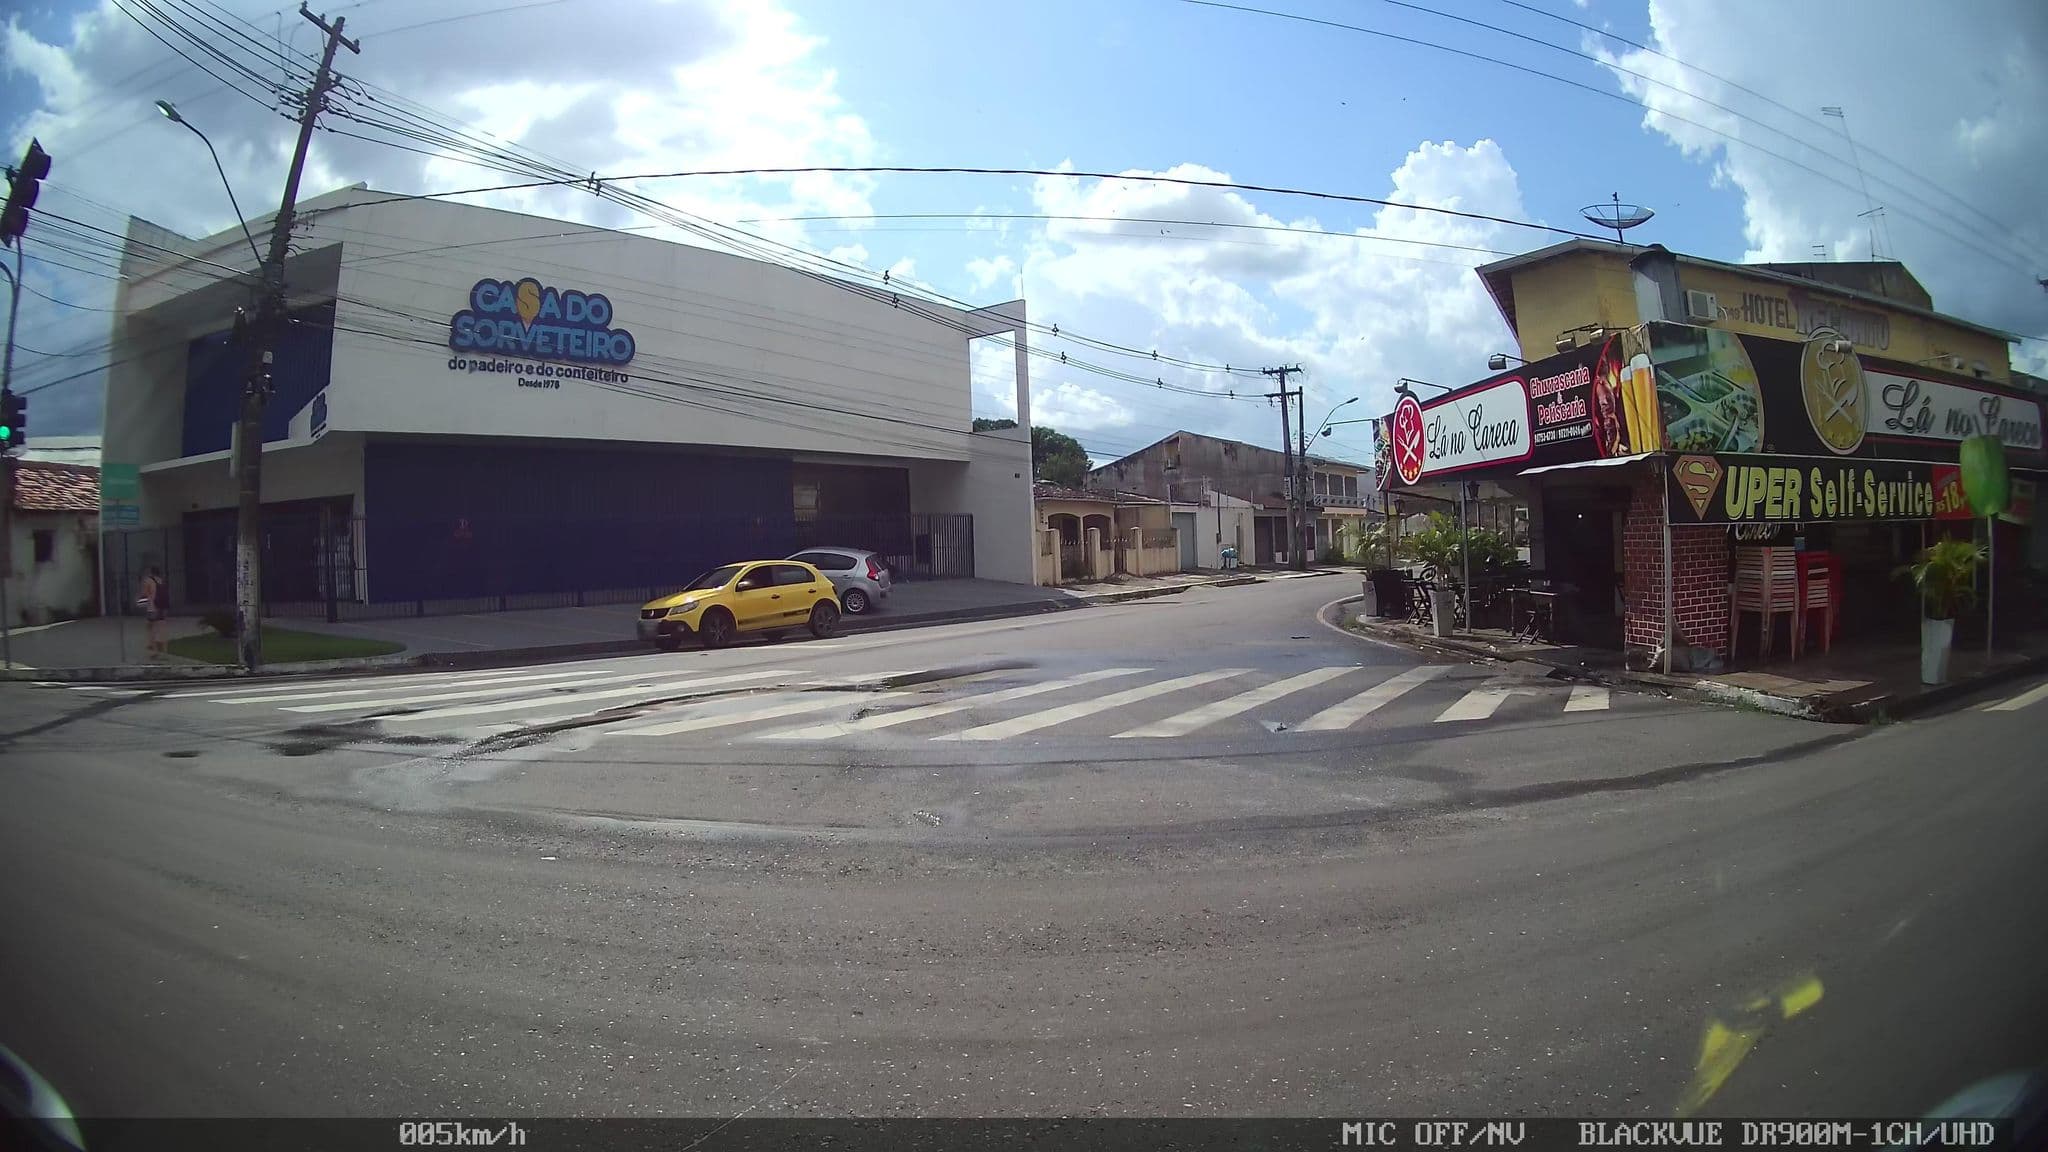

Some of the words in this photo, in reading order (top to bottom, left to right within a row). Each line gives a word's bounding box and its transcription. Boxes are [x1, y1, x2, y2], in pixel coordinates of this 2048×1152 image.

[475, 281, 561, 319] CASA
[566, 294, 609, 325] DO
[1741, 292, 1797, 331] HOTEL
[454, 315, 633, 360] SORVETEIRO
[448, 357, 466, 370] do
[468, 359, 523, 374] padeiro
[524, 365, 534, 375] e
[535, 364, 554, 377] do
[555, 366, 629, 383] confeiteiro
[518, 377, 542, 389] Desde
[1529, 365, 1590, 399] Churrascaria
[1537, 396, 1587, 425] Petiscaria
[1883, 380, 1935, 434] Lá
[1426, 414, 1449, 460] Lá
[1449, 429, 1466, 455] no
[1467, 403, 1519, 454] Careca
[1810, 467, 1934, 519] Self-Service
